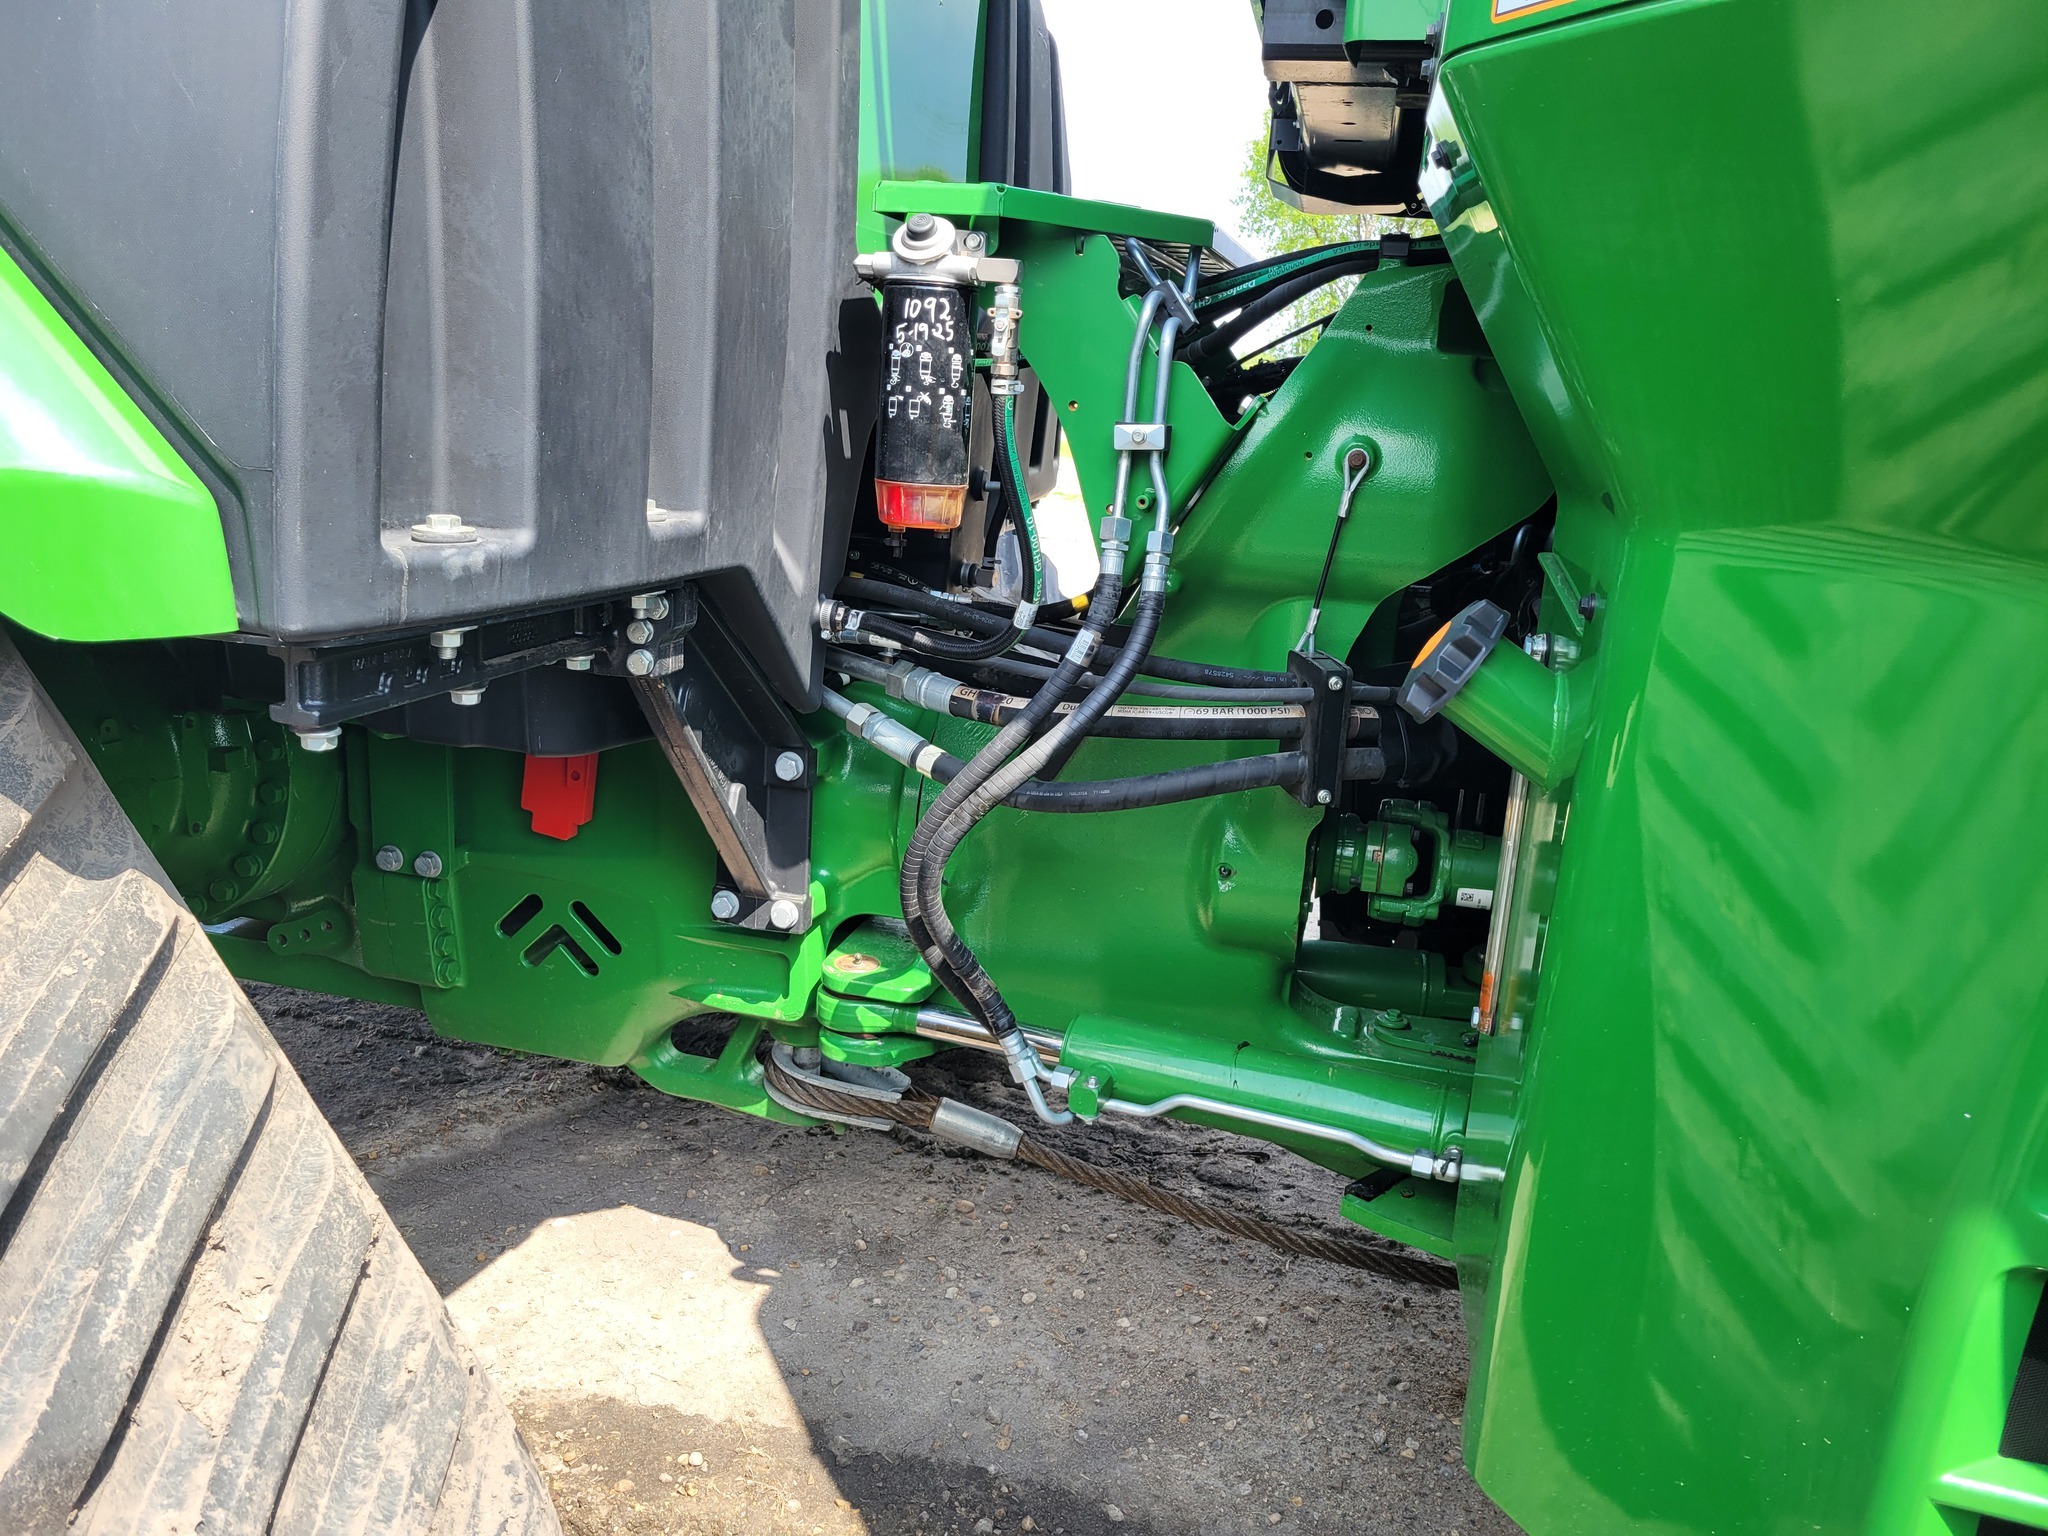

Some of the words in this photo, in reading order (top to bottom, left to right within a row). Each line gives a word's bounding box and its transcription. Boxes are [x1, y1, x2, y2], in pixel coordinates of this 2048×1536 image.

[1217, 279, 1256, 299] Danfoss
[904, 297, 951, 323] 1092
[1027, 516, 1042, 572] GH100-10
[1034, 578, 1042, 604] foss
[1212, 707, 1234, 715] BAR
[1236, 707, 1267, 716] (1000
[1270, 707, 1290, 716] PSI)
